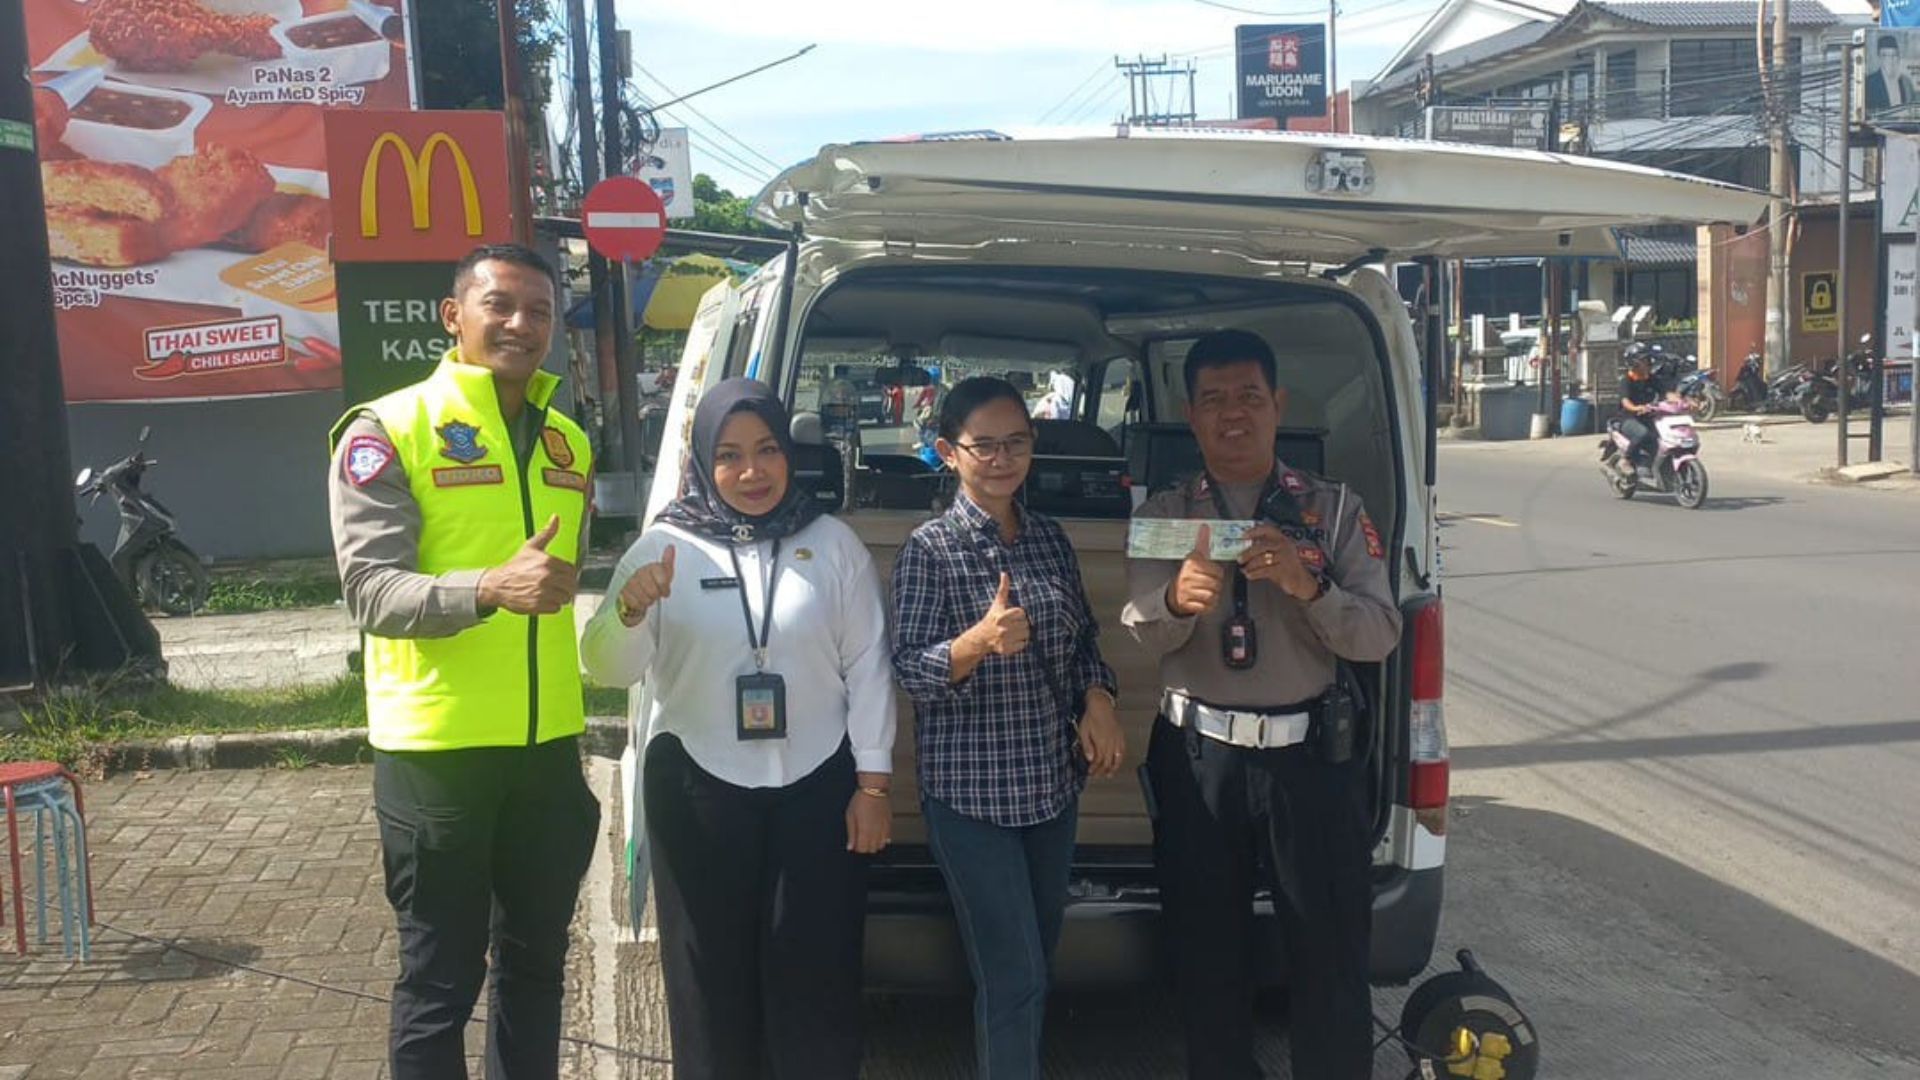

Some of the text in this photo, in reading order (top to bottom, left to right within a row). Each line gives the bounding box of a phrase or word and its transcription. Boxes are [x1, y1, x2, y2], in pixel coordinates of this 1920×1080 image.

[254, 66, 332, 83] PaNas 2
[1246, 74, 1323, 86] MARUGAME
[226, 86, 364, 105] Ayam McD Spicy
[1265, 86, 1304, 98] UDON
[363, 299, 438, 324] TERI
[151, 322, 277, 352] THAI SWEET
[191, 349, 281, 370] CHILI SAUCE
[382, 338, 454, 361] KAS
